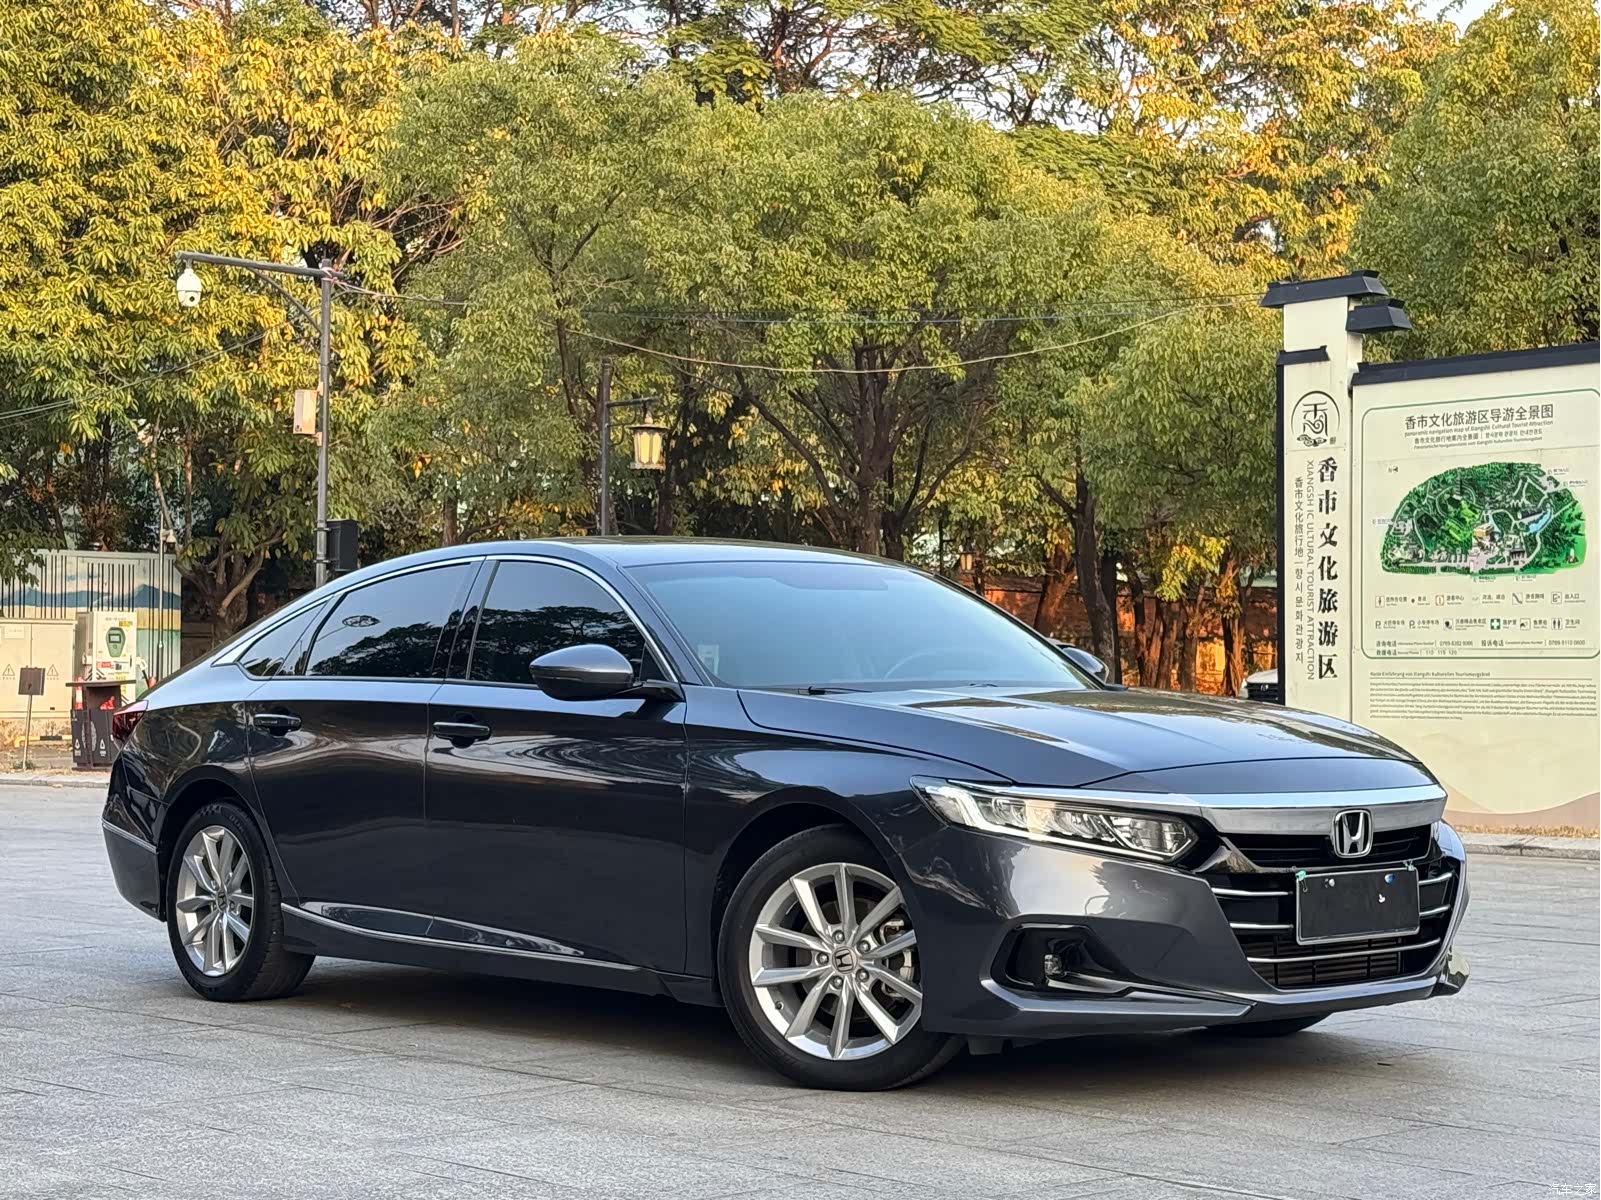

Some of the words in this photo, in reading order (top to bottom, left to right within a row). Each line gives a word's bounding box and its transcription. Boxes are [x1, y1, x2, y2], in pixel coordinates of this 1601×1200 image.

[1404, 404, 1553, 429] 香市文化旅游区导游全景图
[1306, 570, 1314, 613] TOURIST
[1317, 457, 1338, 679] 香市文化旅游区
[1306, 615, 1314, 680] ATTRACTION
